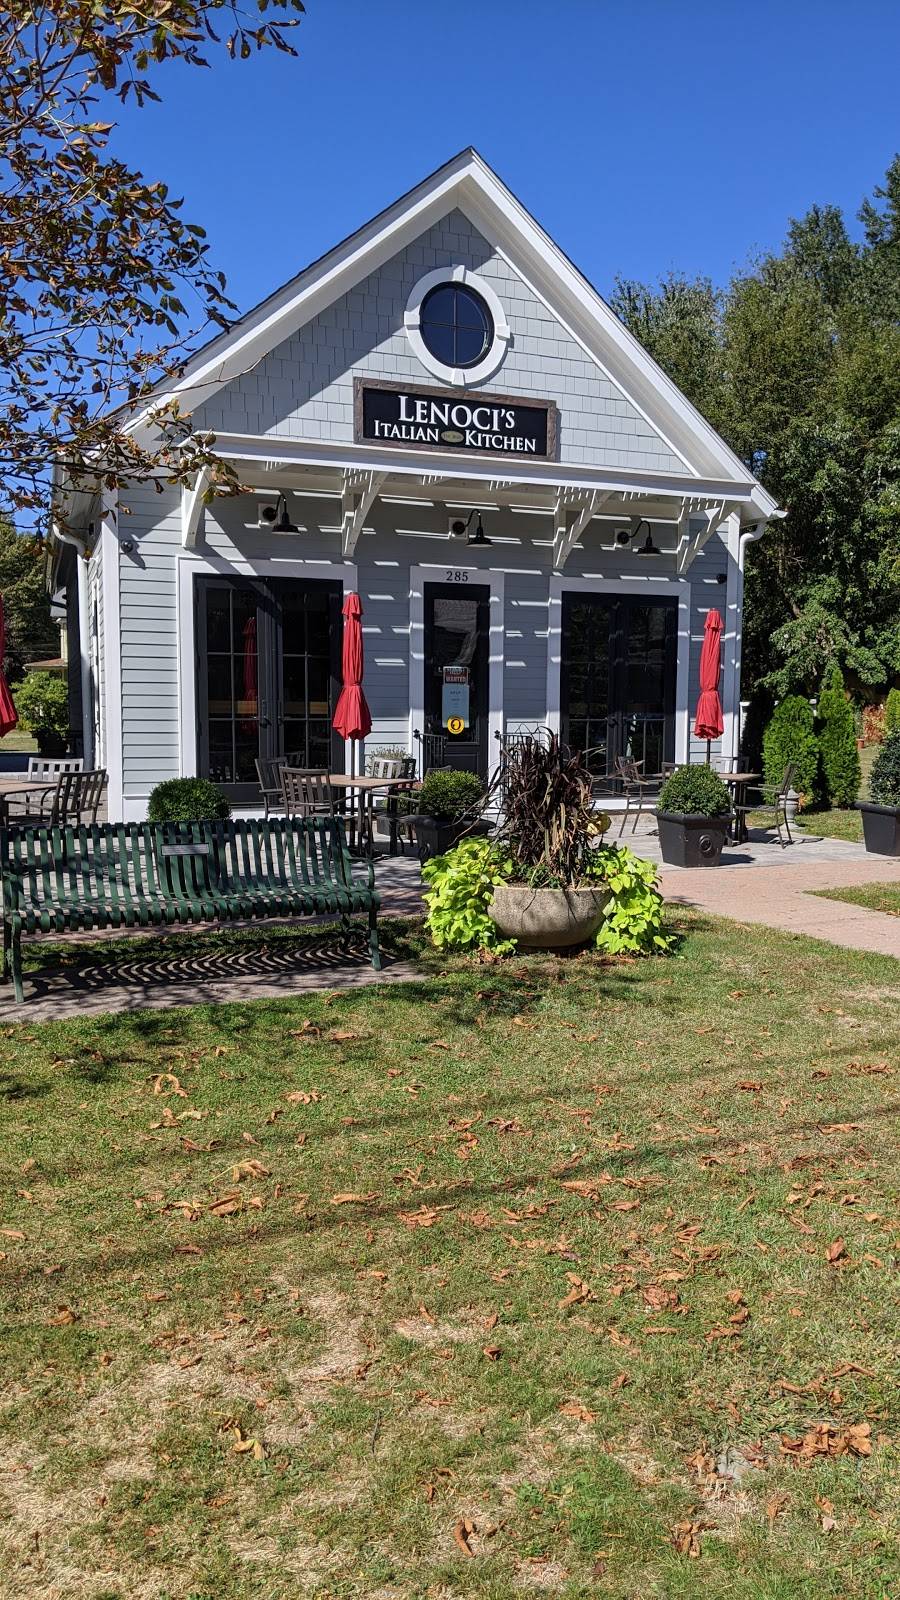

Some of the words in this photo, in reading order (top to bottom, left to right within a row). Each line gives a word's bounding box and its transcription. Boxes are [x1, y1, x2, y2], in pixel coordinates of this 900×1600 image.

[398, 395, 515, 431] LENOCI'S
[374, 420, 439, 442] ITALIAN
[465, 429, 536, 452] KITCHEN
[446, 571, 469, 582] 285
